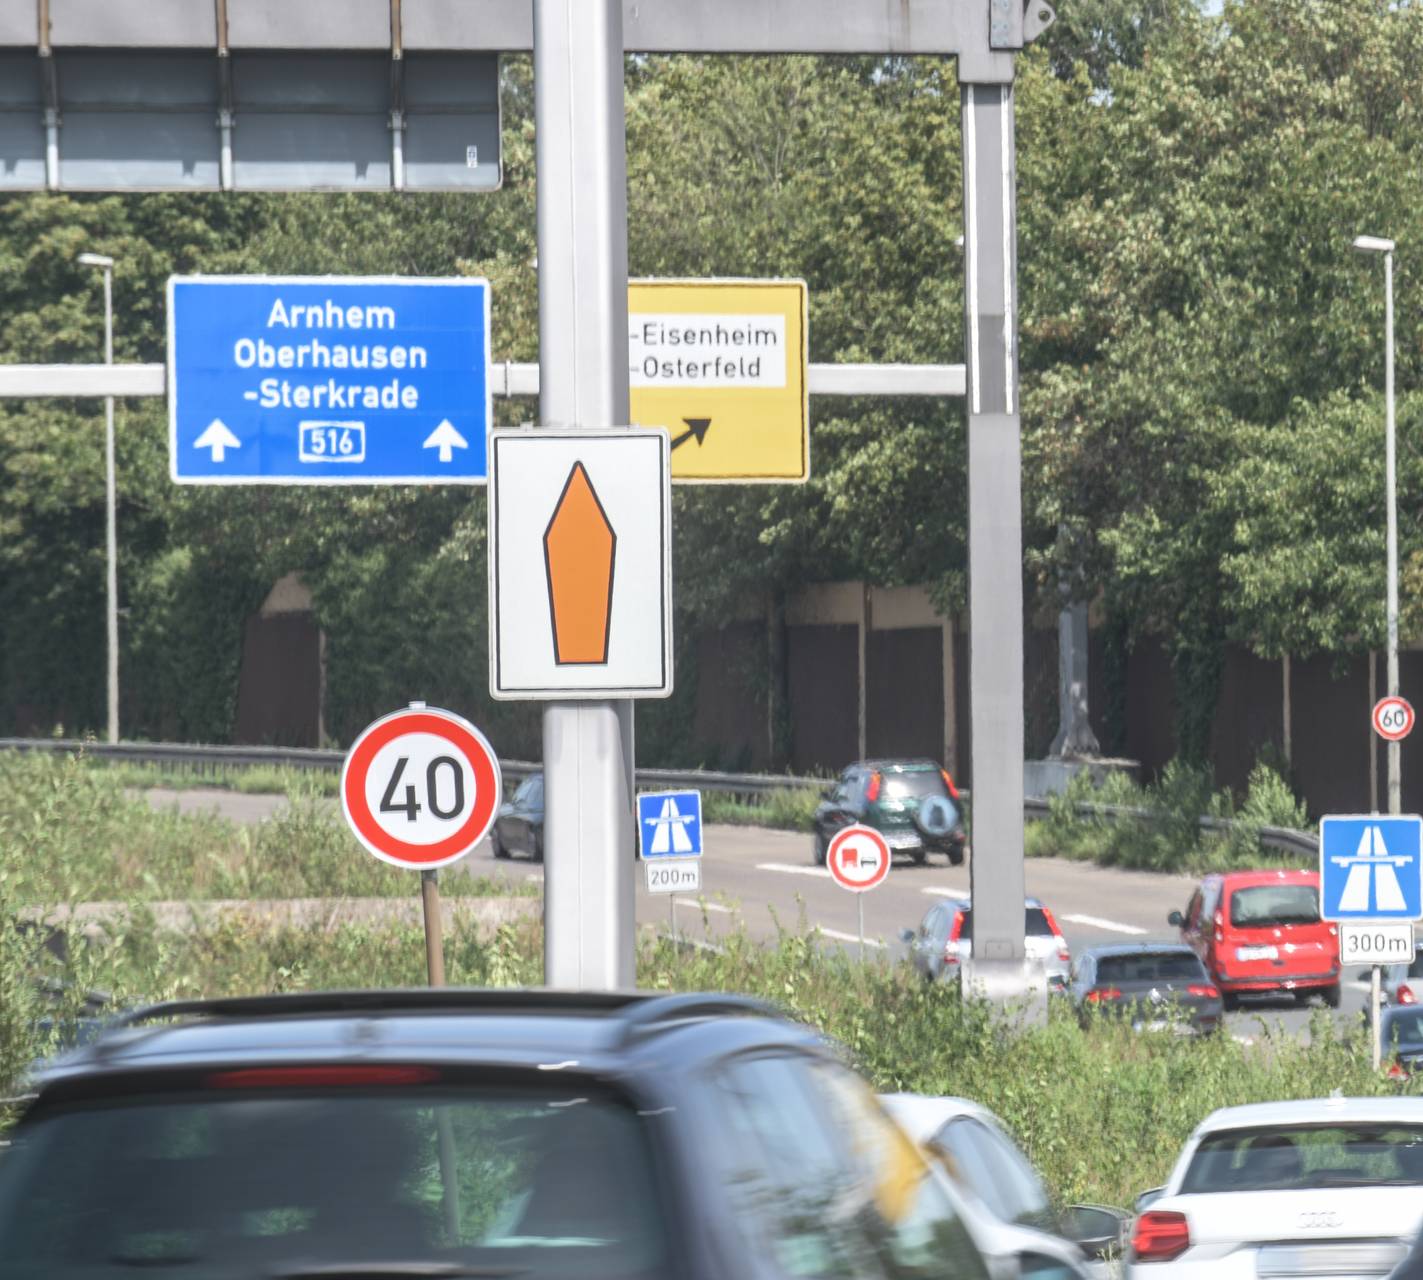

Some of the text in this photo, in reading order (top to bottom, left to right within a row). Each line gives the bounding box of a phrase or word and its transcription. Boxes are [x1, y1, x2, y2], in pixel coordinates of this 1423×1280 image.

[267, 299, 395, 330] Arnhem
[630, 322, 778, 346] -Eisenheim
[234, 338, 428, 370] Oberhausen
[630, 355, 762, 379] -Osterfeld
[243, 377, 420, 409] -Sterkrade
[310, 427, 354, 455] 516
[1383, 708, 1405, 728] 60
[379, 755, 465, 823] 40
[651, 867, 697, 888] 200m
[1348, 932, 1407, 955] 300m
